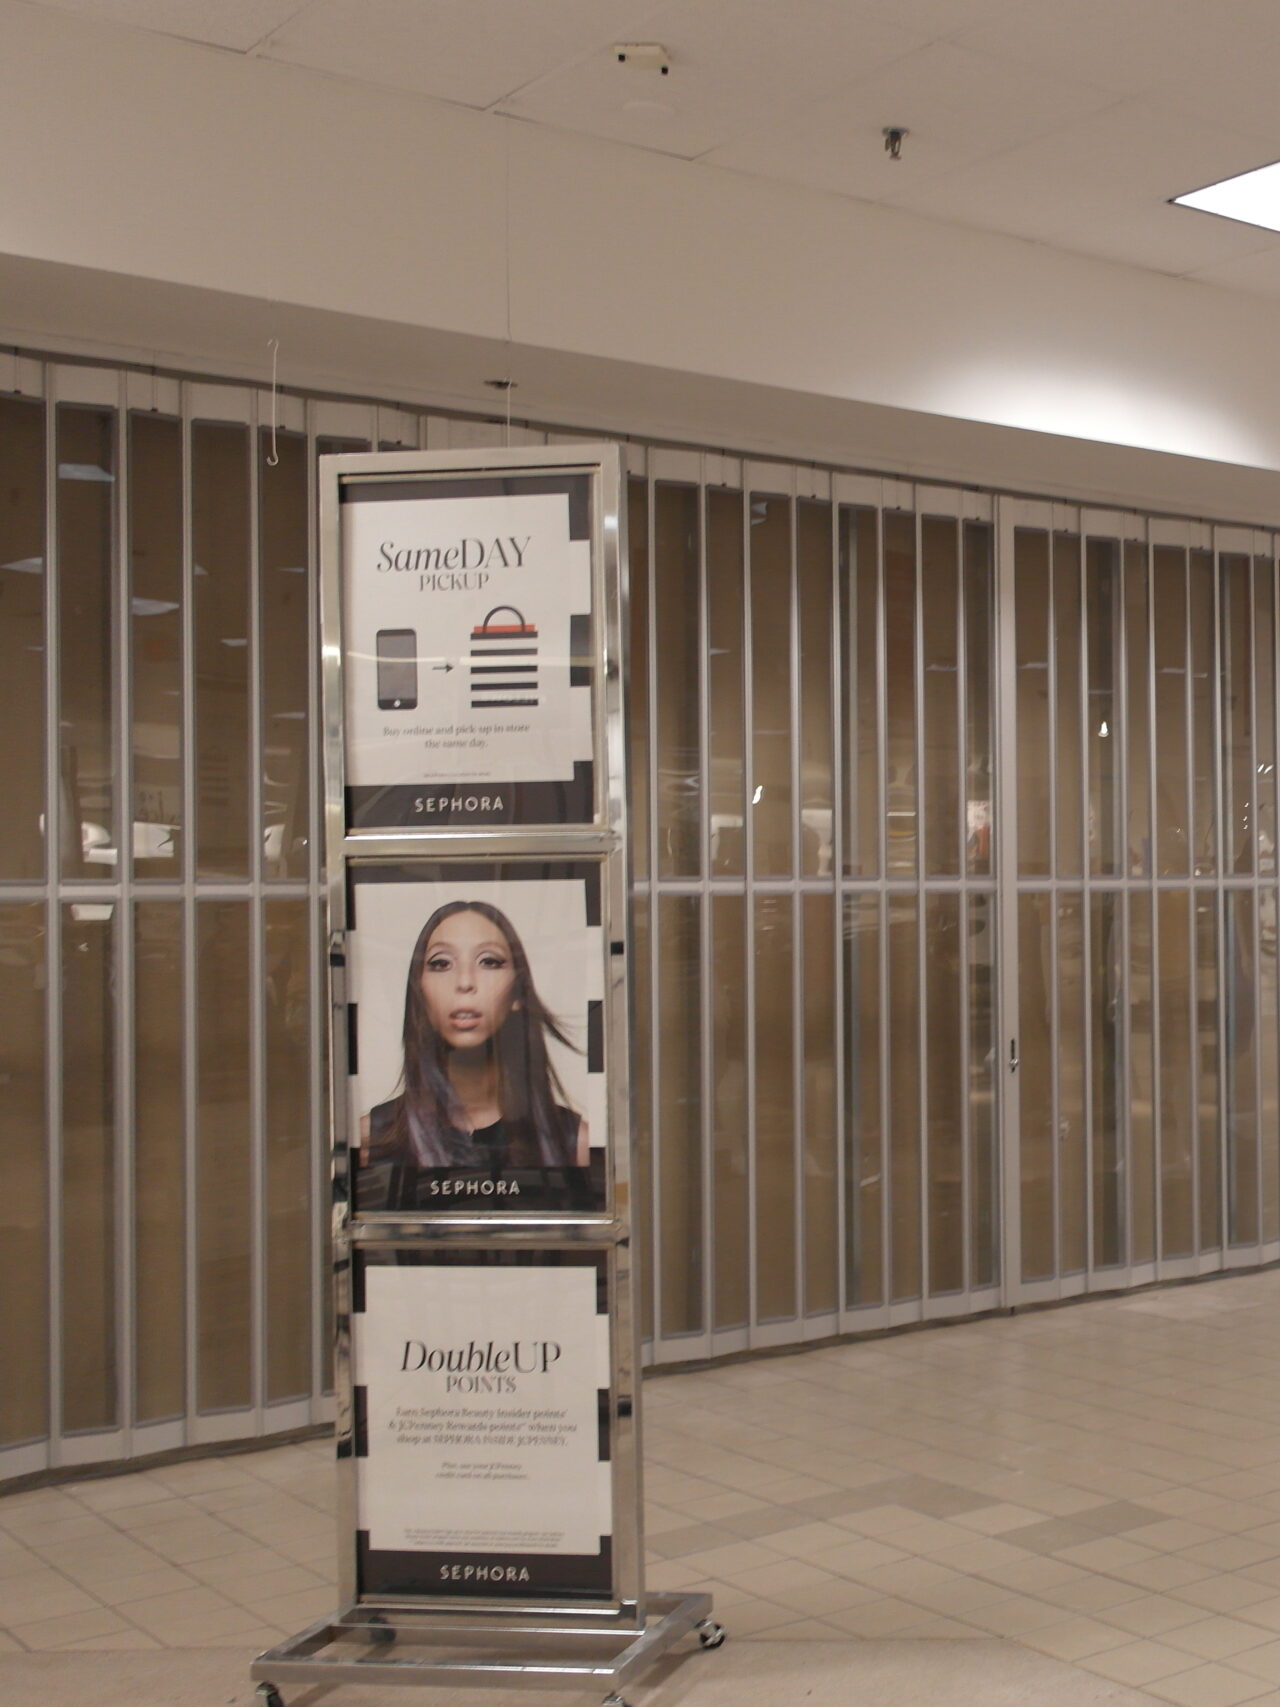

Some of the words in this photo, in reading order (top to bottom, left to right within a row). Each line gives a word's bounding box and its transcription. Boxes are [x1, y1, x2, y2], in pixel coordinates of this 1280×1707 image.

[377, 536, 531, 573] SameDAY
[419, 573, 490, 592] PICKUP
[402, 725, 433, 736] online
[435, 724, 454, 735] and
[493, 724, 504, 734] in
[505, 722, 530, 733] store
[424, 738, 441, 749] the
[442, 739, 467, 748] same
[414, 796, 505, 813] SEPHORA
[430, 1180, 521, 1196] SEPHORA
[400, 1339, 561, 1374] DoubleUP
[445, 1375, 517, 1394] POINTS
[439, 1564, 530, 1582] SEPHORA
